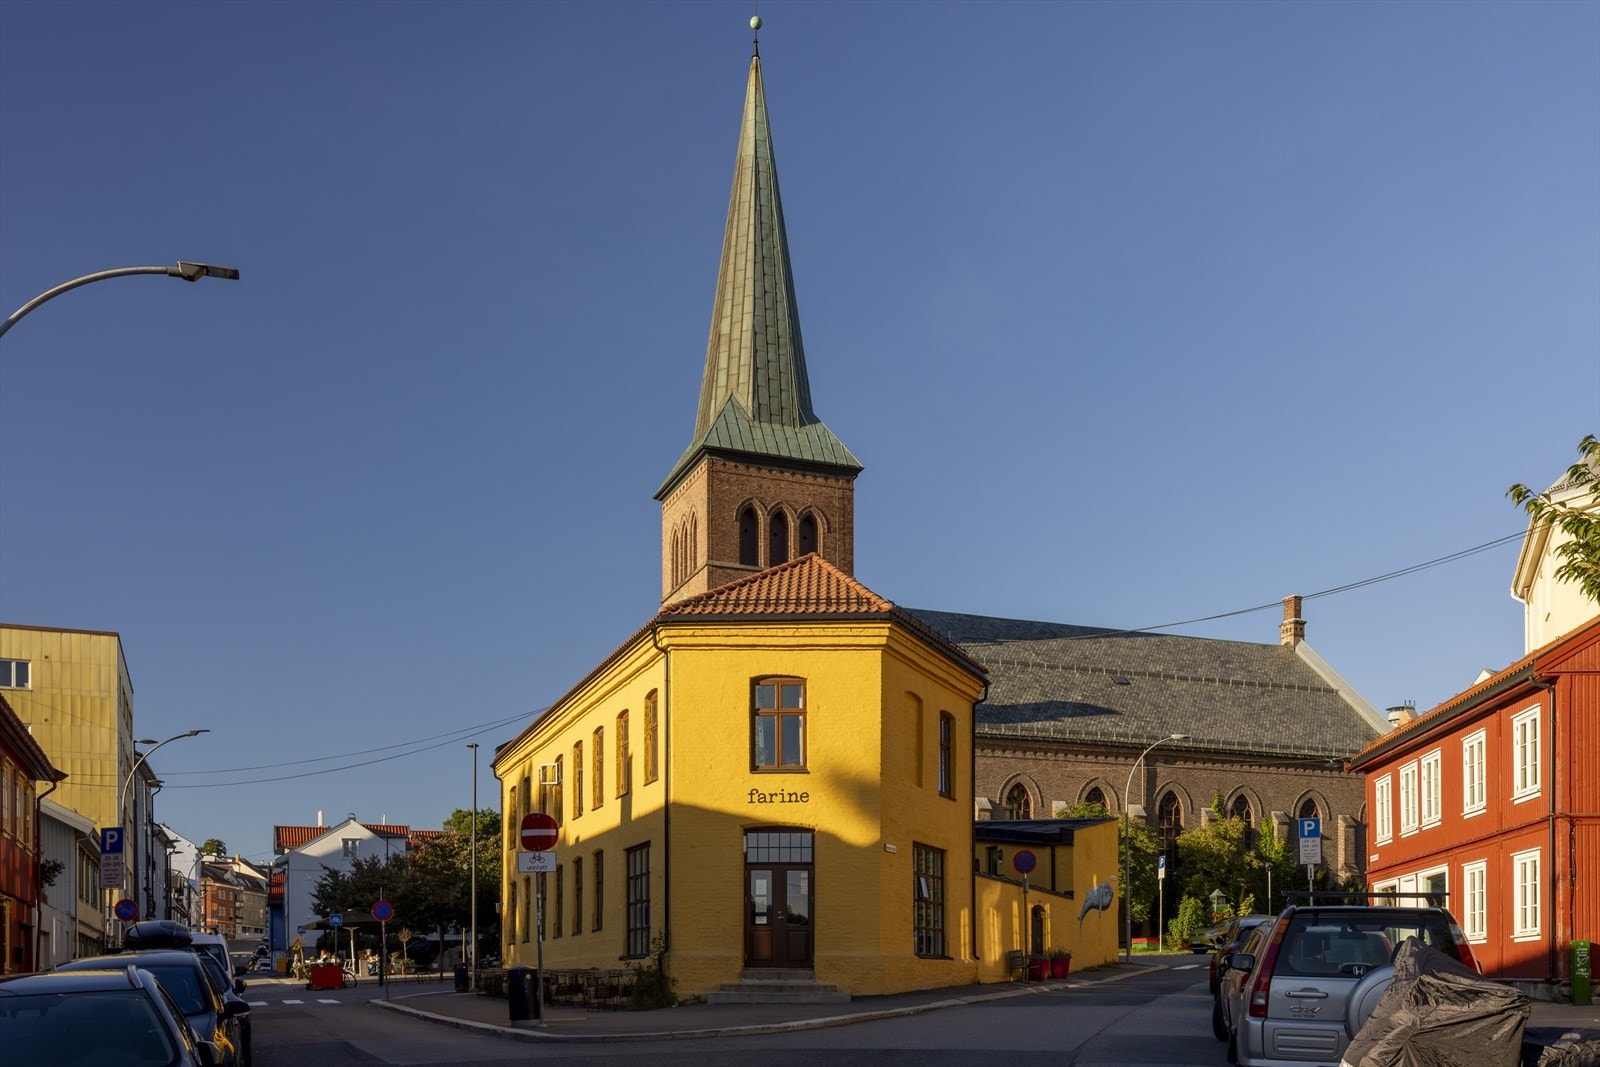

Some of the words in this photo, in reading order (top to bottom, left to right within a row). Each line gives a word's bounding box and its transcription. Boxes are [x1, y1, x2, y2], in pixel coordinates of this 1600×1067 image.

[748, 788, 810, 803] farine
[1304, 821, 1315, 836] P
[106, 831, 118, 850] P
